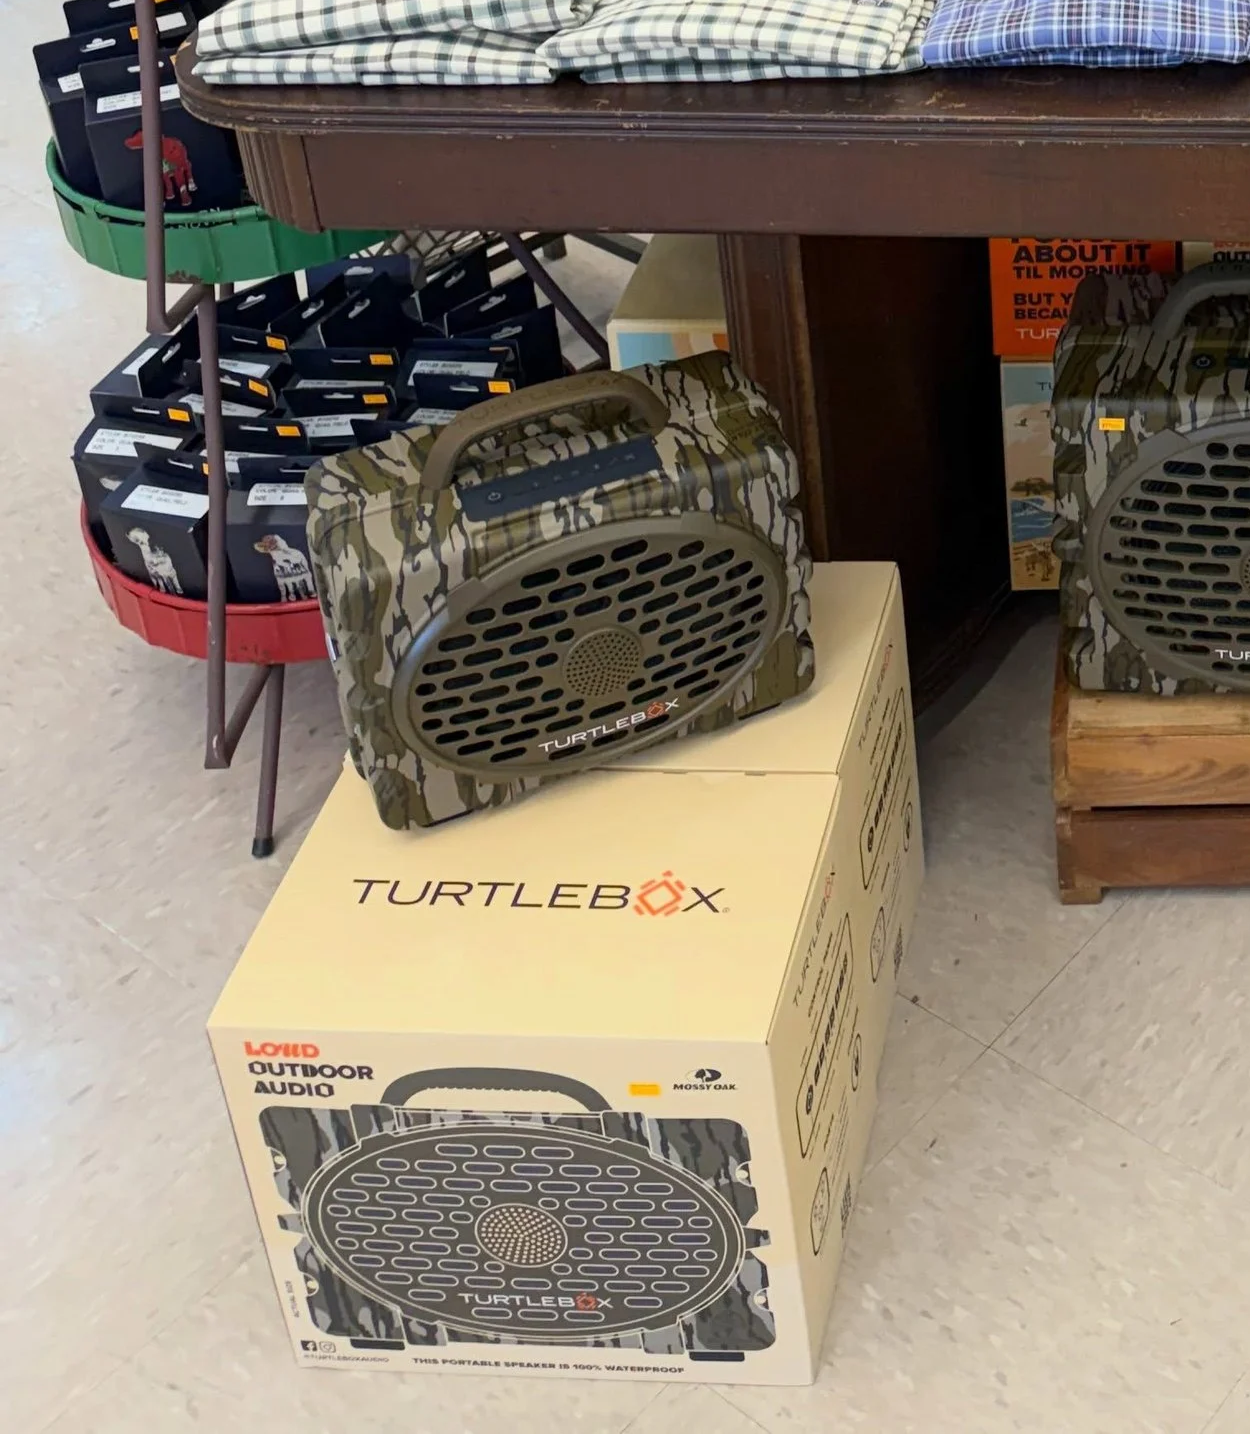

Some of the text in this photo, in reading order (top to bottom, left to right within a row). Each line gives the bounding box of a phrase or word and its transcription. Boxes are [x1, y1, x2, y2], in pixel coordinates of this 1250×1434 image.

[1013, 244, 1151, 263] ABOUT IT
[1013, 267, 1042, 279] TIL
[1014, 293, 1052, 306] BUT
[538, 696, 680, 753] TURTLEBOX
[353, 870, 726, 916] TURTLEBOX
[244, 1041, 320, 1059] LOUD
[248, 1060, 374, 1080] OUTDOOR
[254, 1080, 335, 1098] AUDIO
[457, 1291, 614, 1311] TURTLEBOX
[412, 1357, 685, 1374] THIS PORTABLE SPEAKER IS 100% WATERPROOF
